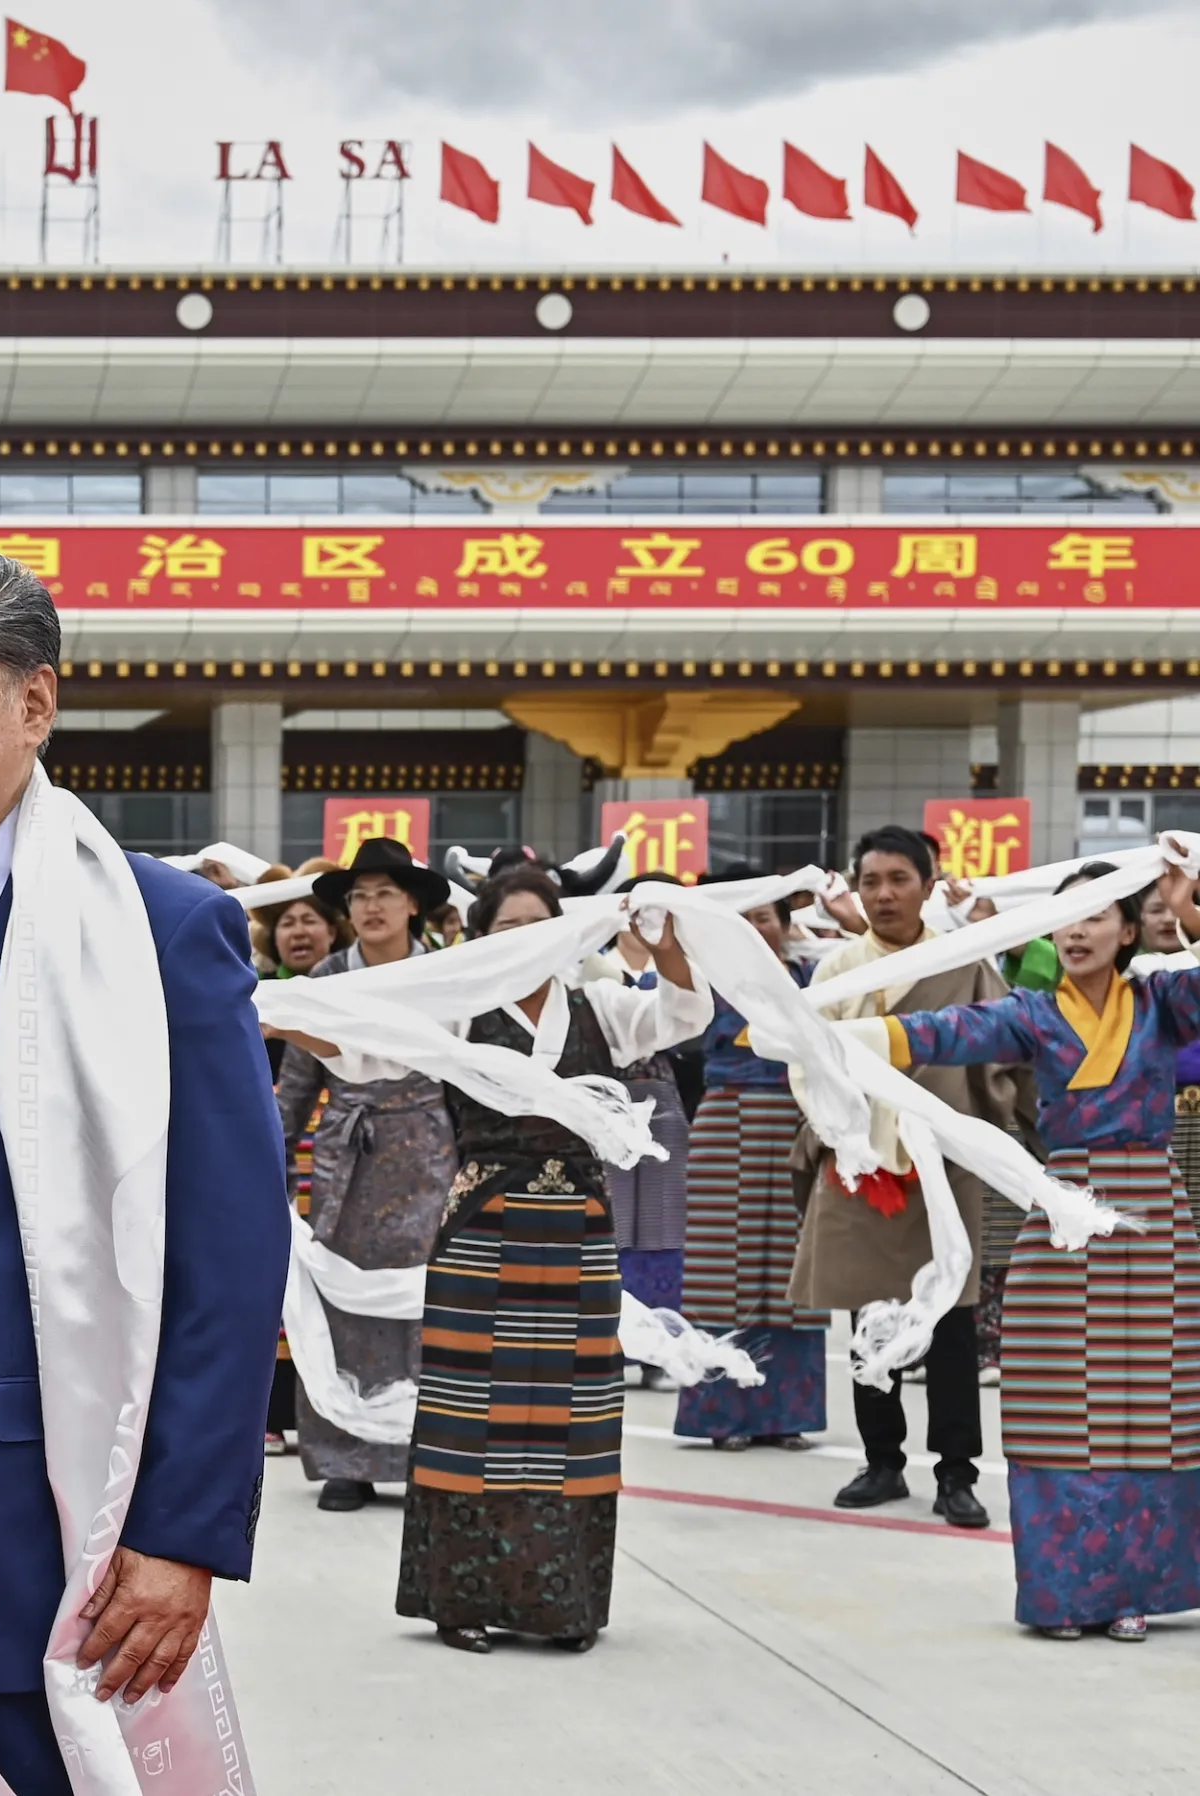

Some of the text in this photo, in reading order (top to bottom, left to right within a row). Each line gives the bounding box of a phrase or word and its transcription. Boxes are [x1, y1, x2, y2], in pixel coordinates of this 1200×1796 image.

[214, 140, 411, 180] LA SA
[938, 809, 1021, 879] 新
